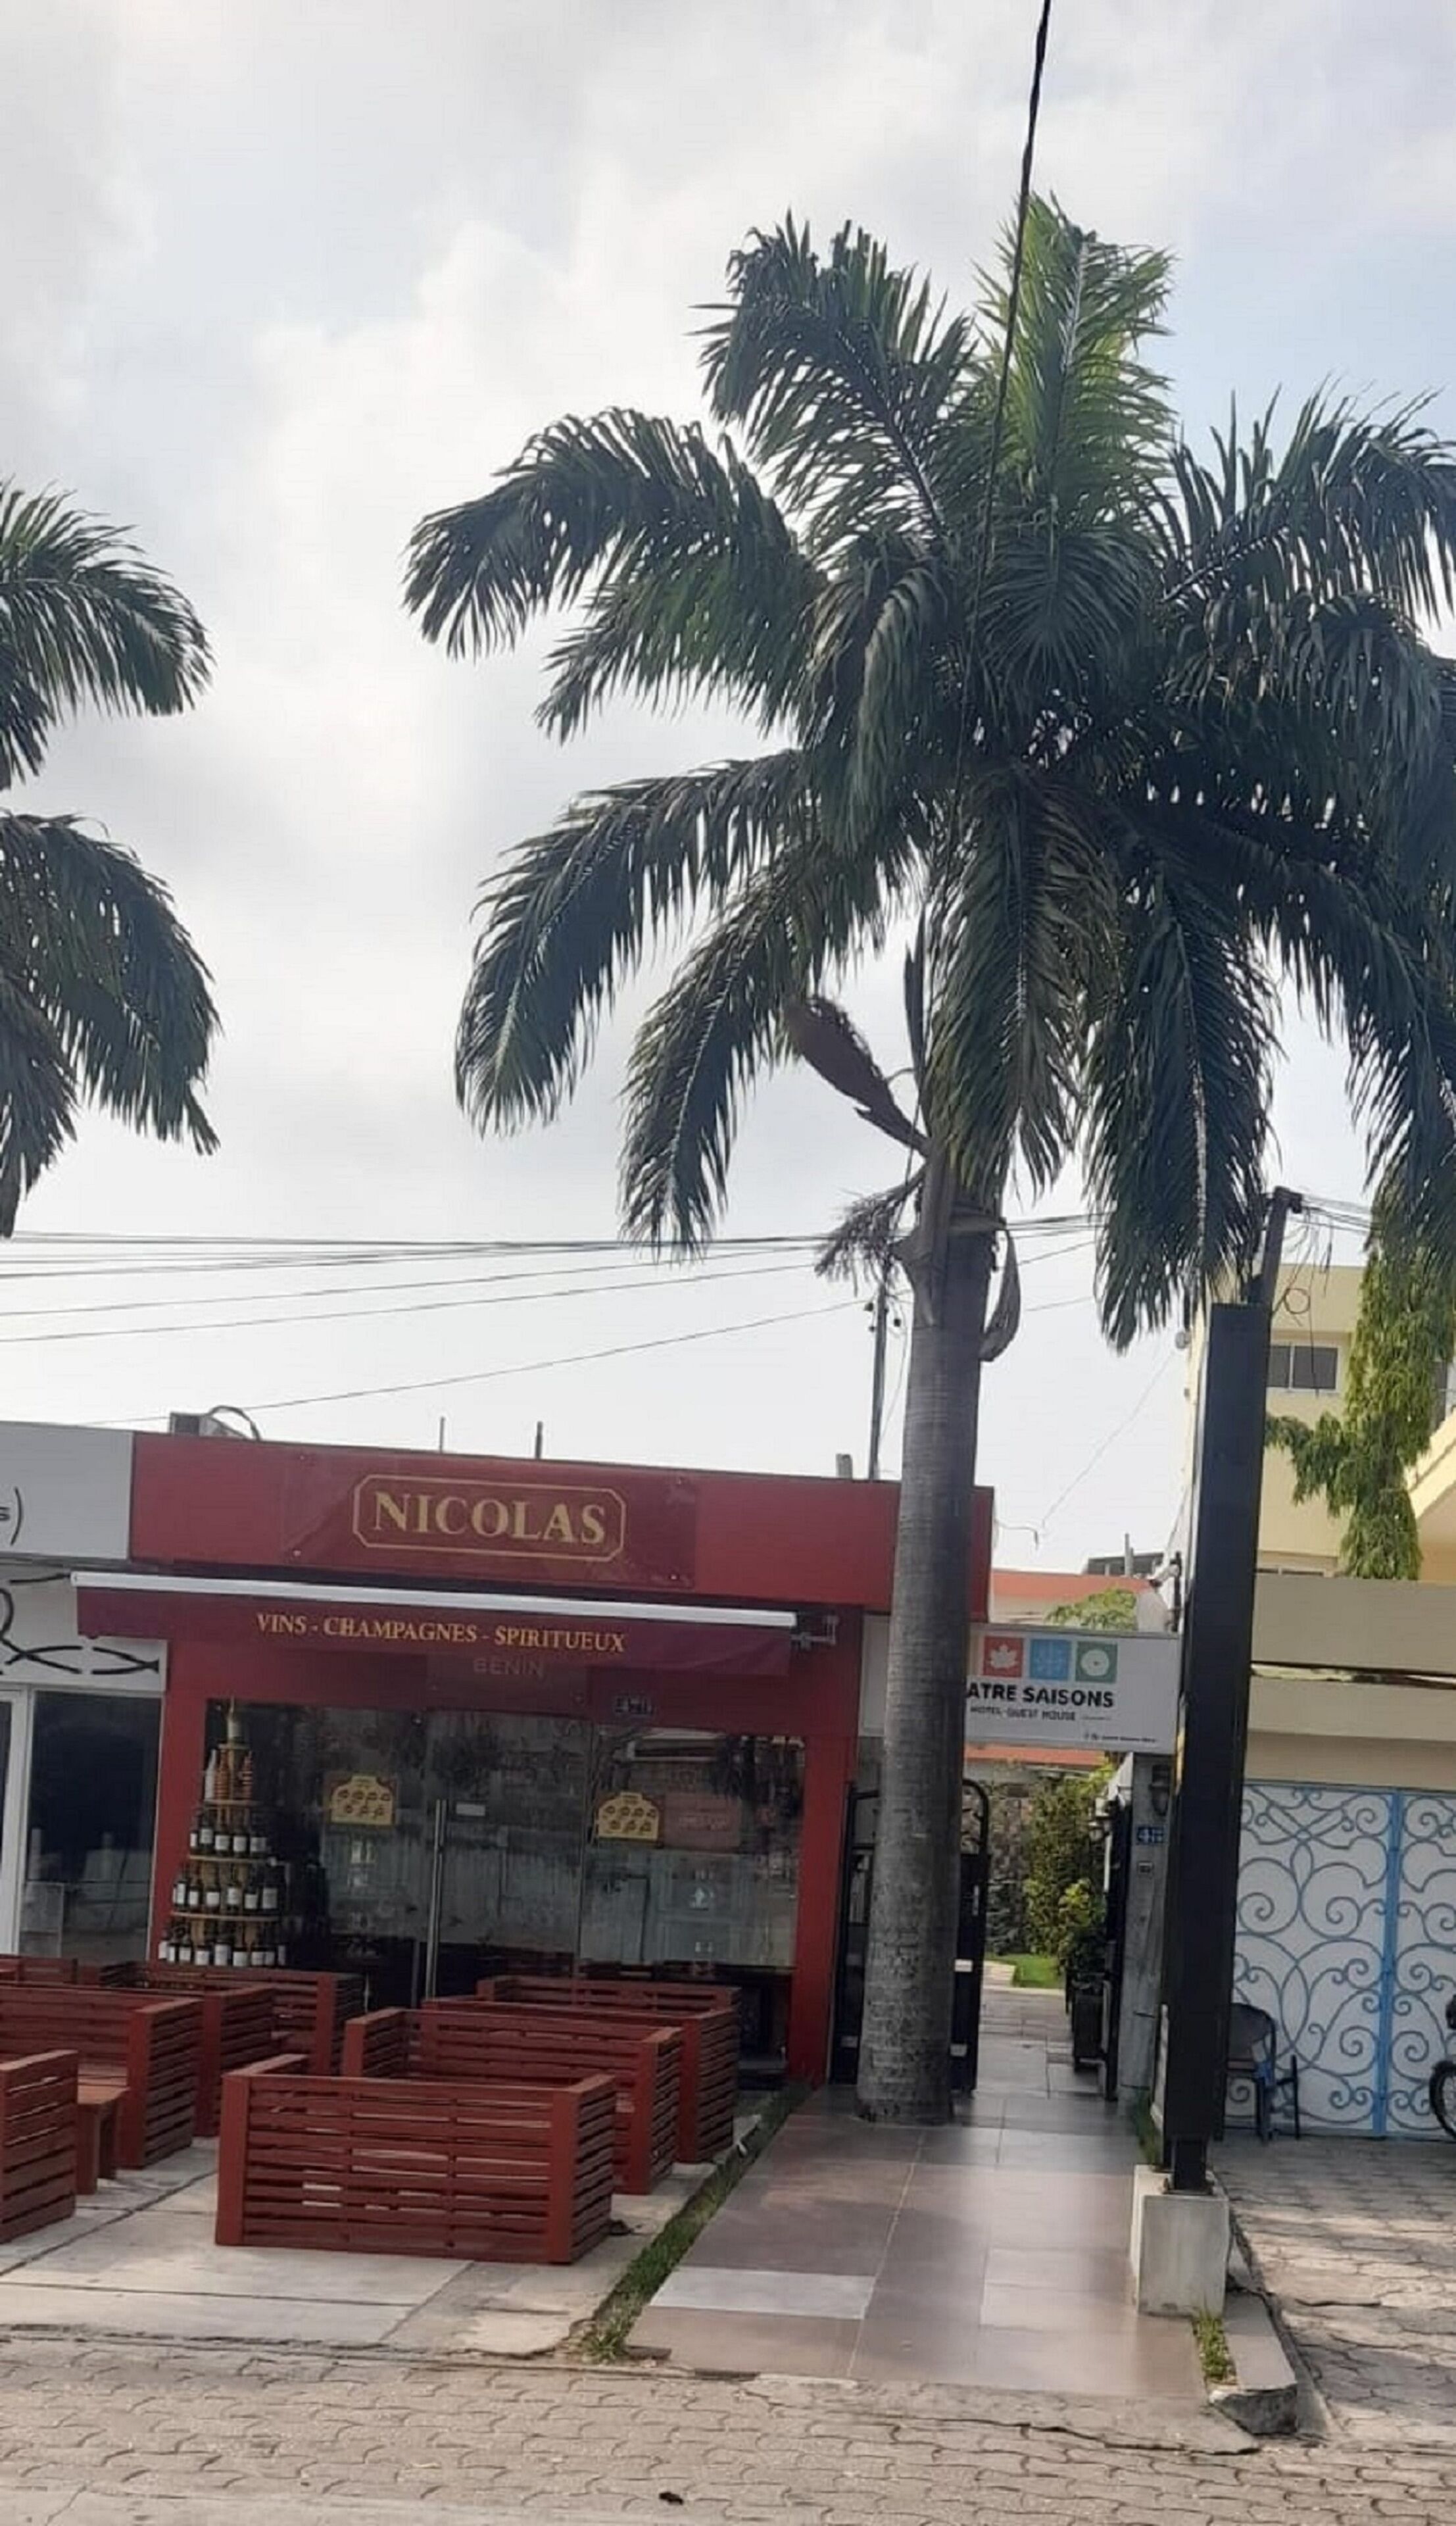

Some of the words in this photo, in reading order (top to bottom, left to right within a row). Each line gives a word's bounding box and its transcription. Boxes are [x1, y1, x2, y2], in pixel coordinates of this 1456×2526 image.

[374, 1490, 606, 1545] NICOLAS
[256, 1614, 307, 1634] VINS
[323, 1616, 477, 1643] CHAMPAGNES
[495, 1625, 626, 1652] SPIRITUEUX
[968, 1683, 1017, 1701] ATRE
[1023, 1686, 1114, 1708] SAISONS
[1042, 1710, 1076, 1721] HOUSE
